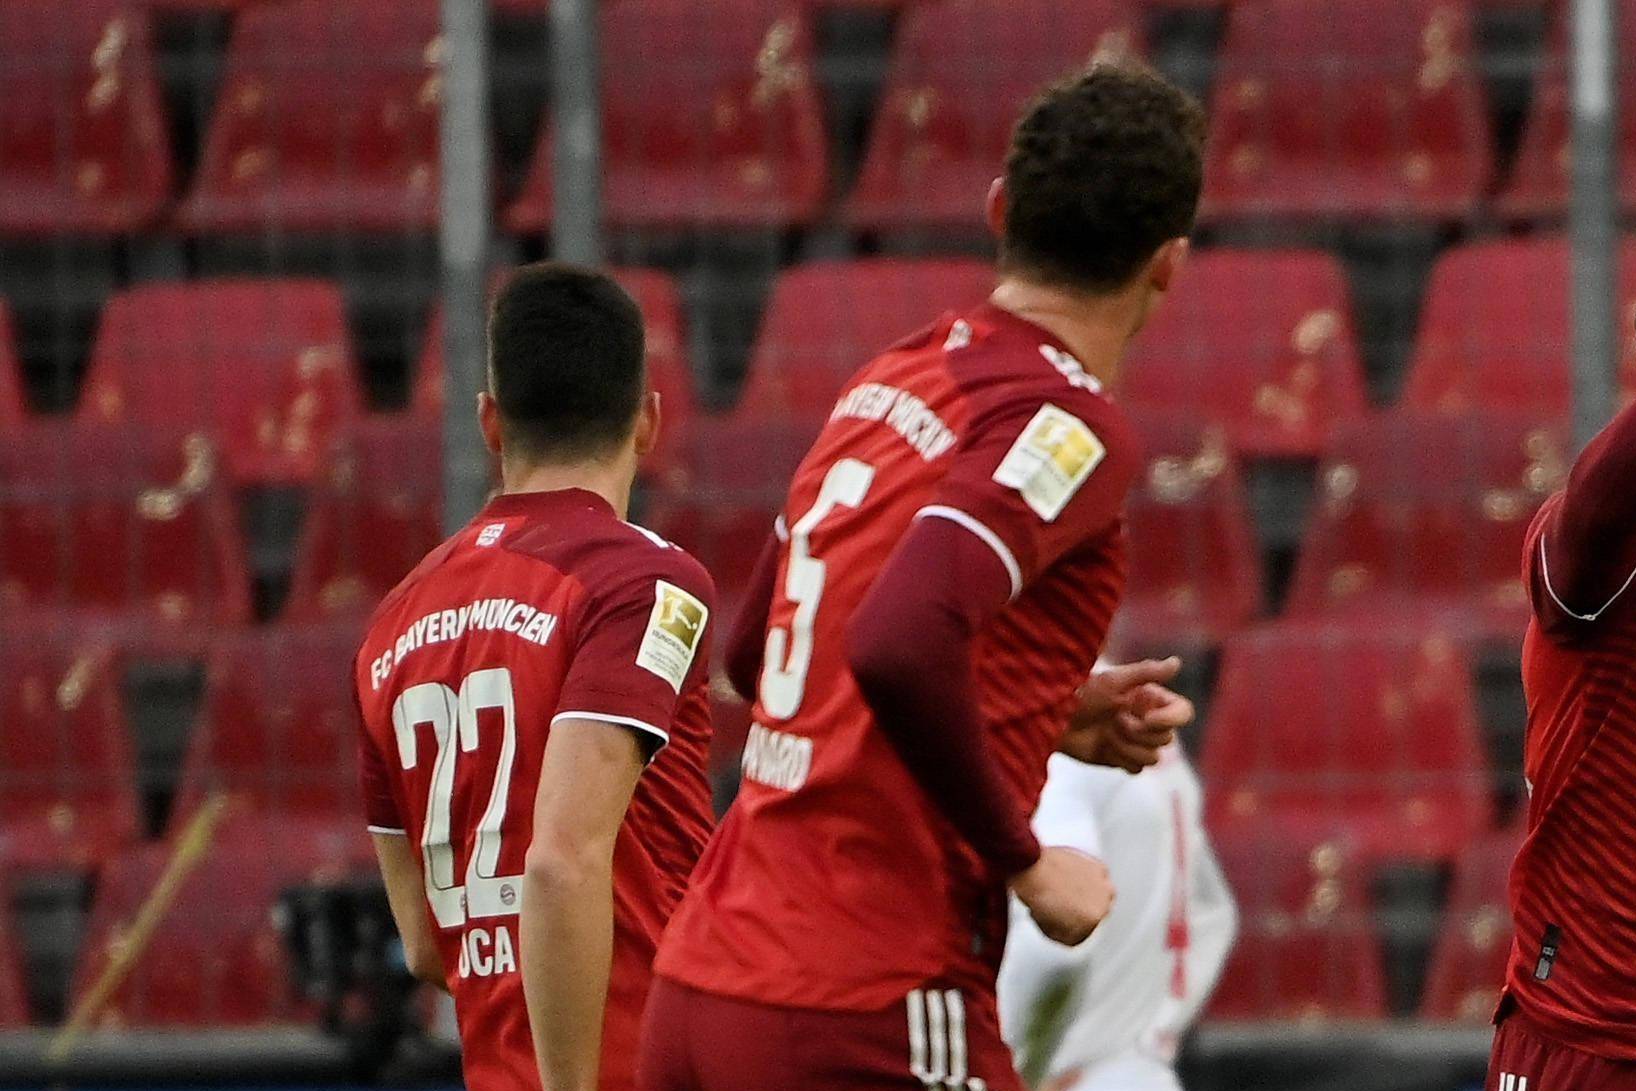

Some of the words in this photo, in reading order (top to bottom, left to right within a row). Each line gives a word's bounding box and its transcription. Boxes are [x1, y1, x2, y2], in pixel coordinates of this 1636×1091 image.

[370, 649, 393, 691] FC
[394, 605, 472, 666] BAYERN
[759, 457, 875, 720] 5
[392, 667, 525, 929] 22
